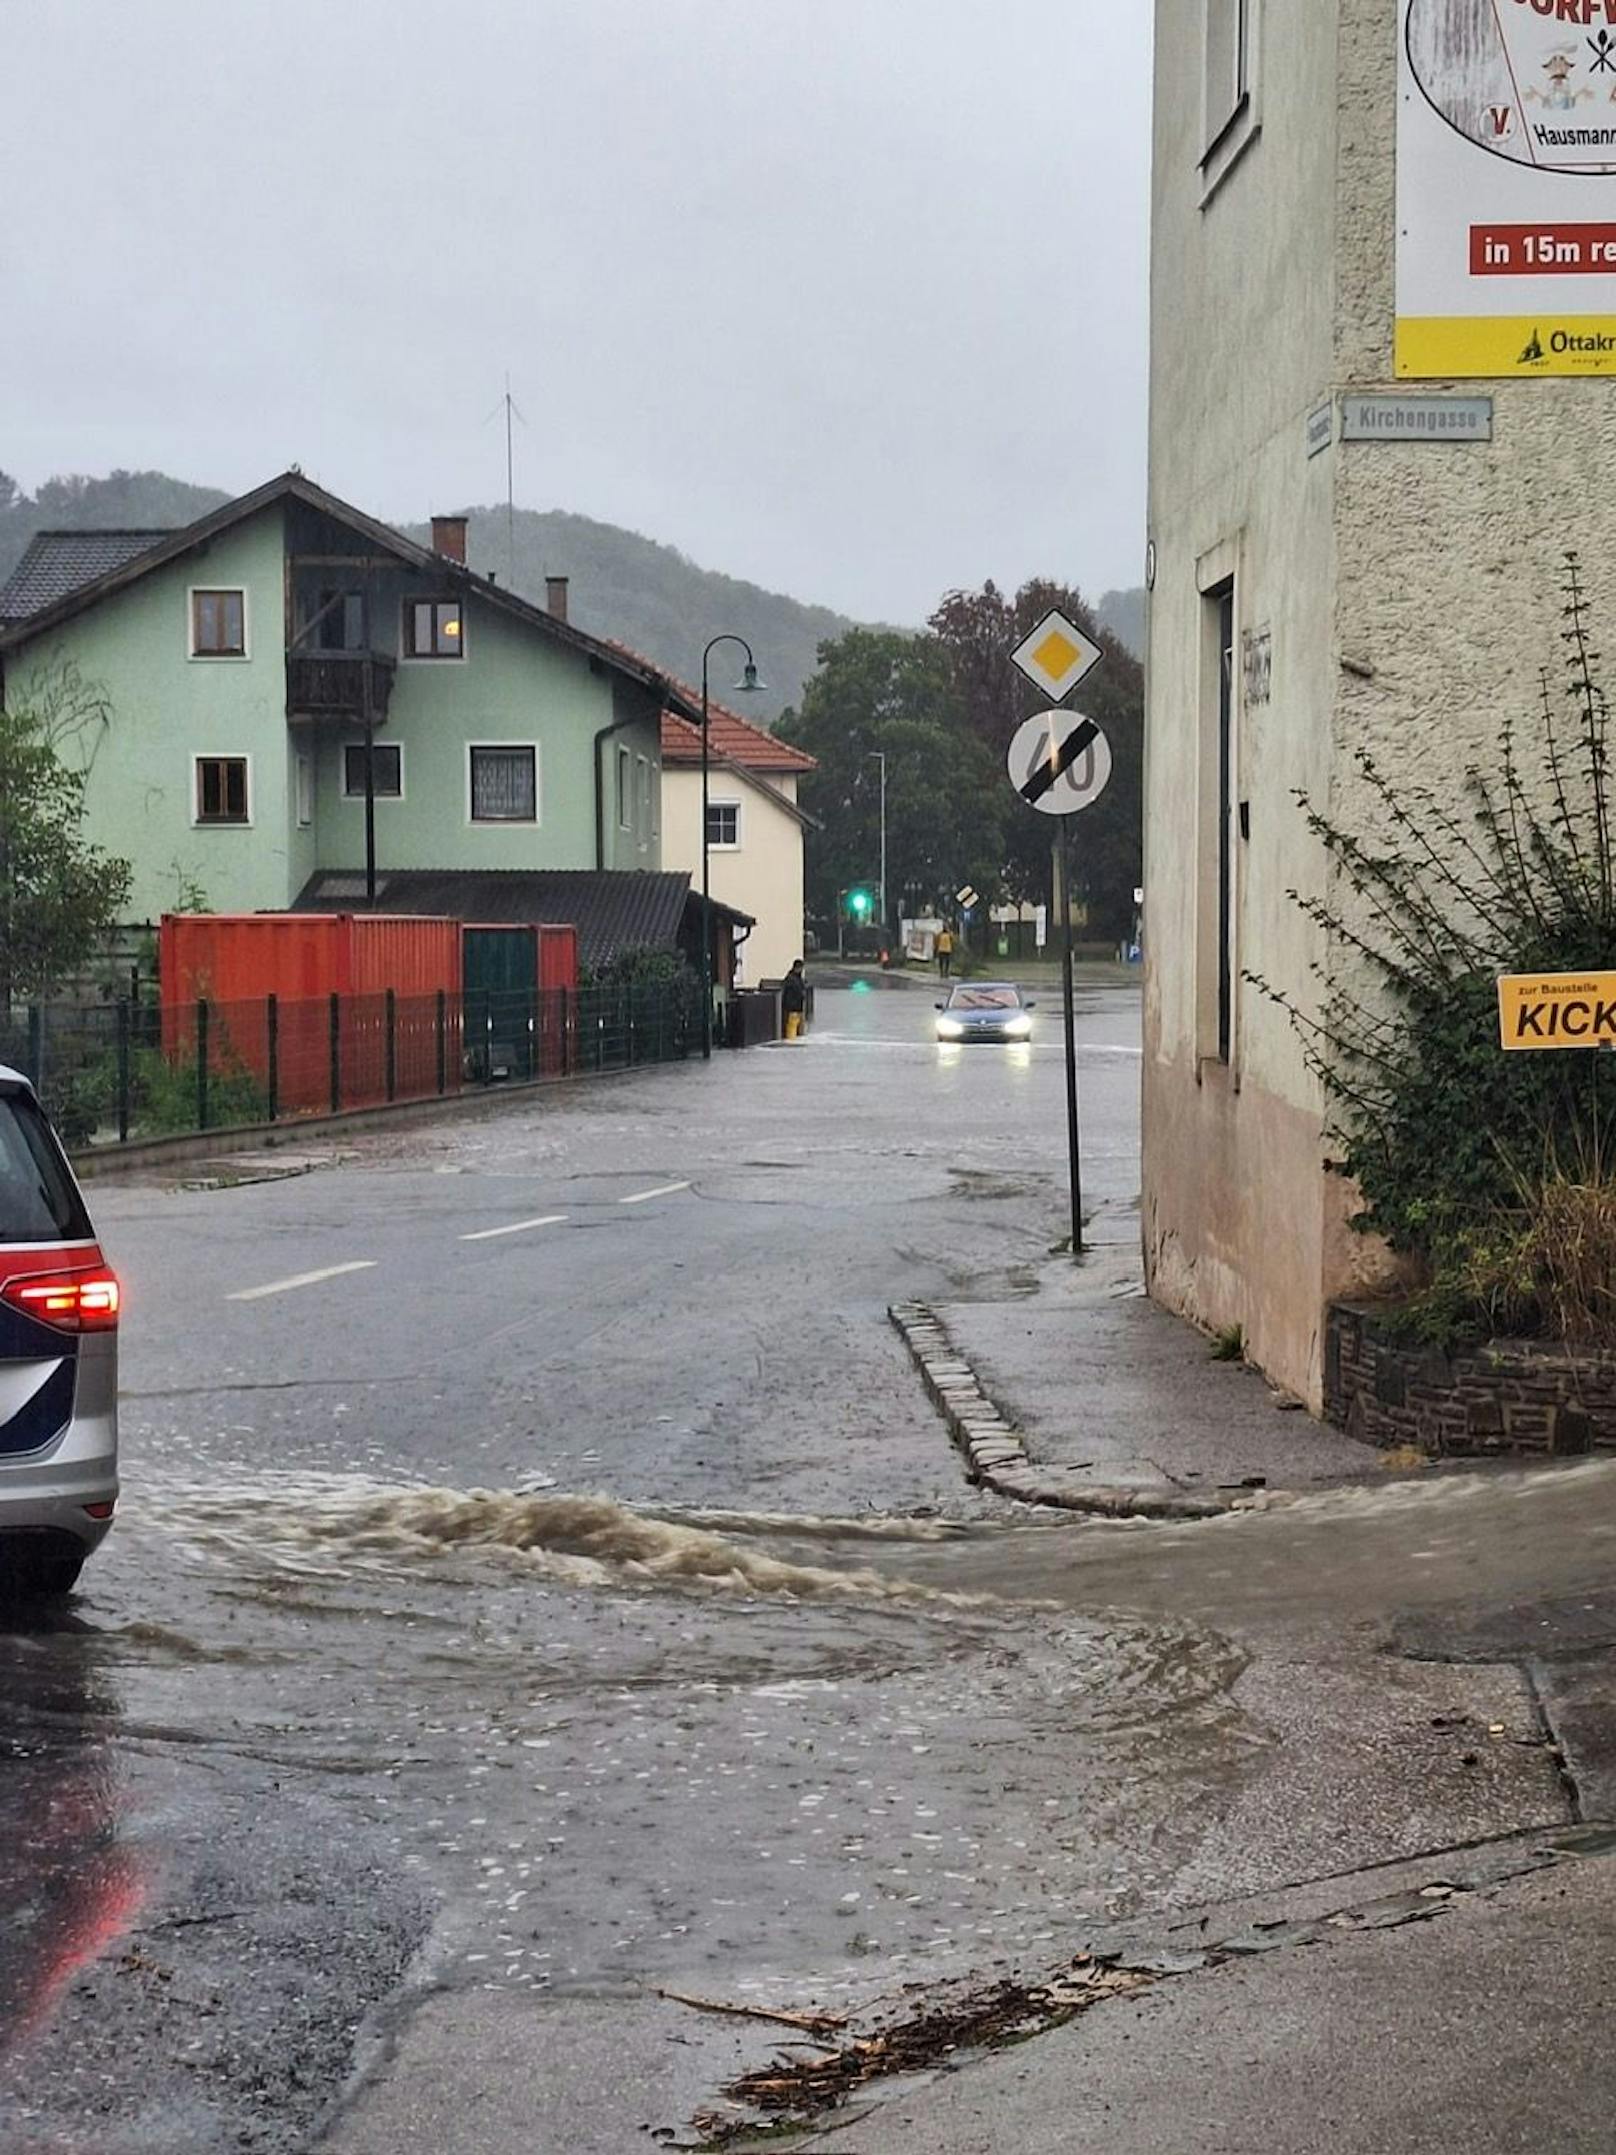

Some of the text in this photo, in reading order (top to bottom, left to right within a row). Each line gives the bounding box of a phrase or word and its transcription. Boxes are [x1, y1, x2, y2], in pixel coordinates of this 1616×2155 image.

[1485, 236, 1509, 264] in
[1523, 235, 1580, 263] 15m
[1550, 330, 1616, 353] Ottakr
[1360, 406, 1478, 431] Kirchengasse
[1519, 983, 1598, 995] zur Baustelle
[1517, 1001, 1616, 1037] KICK
